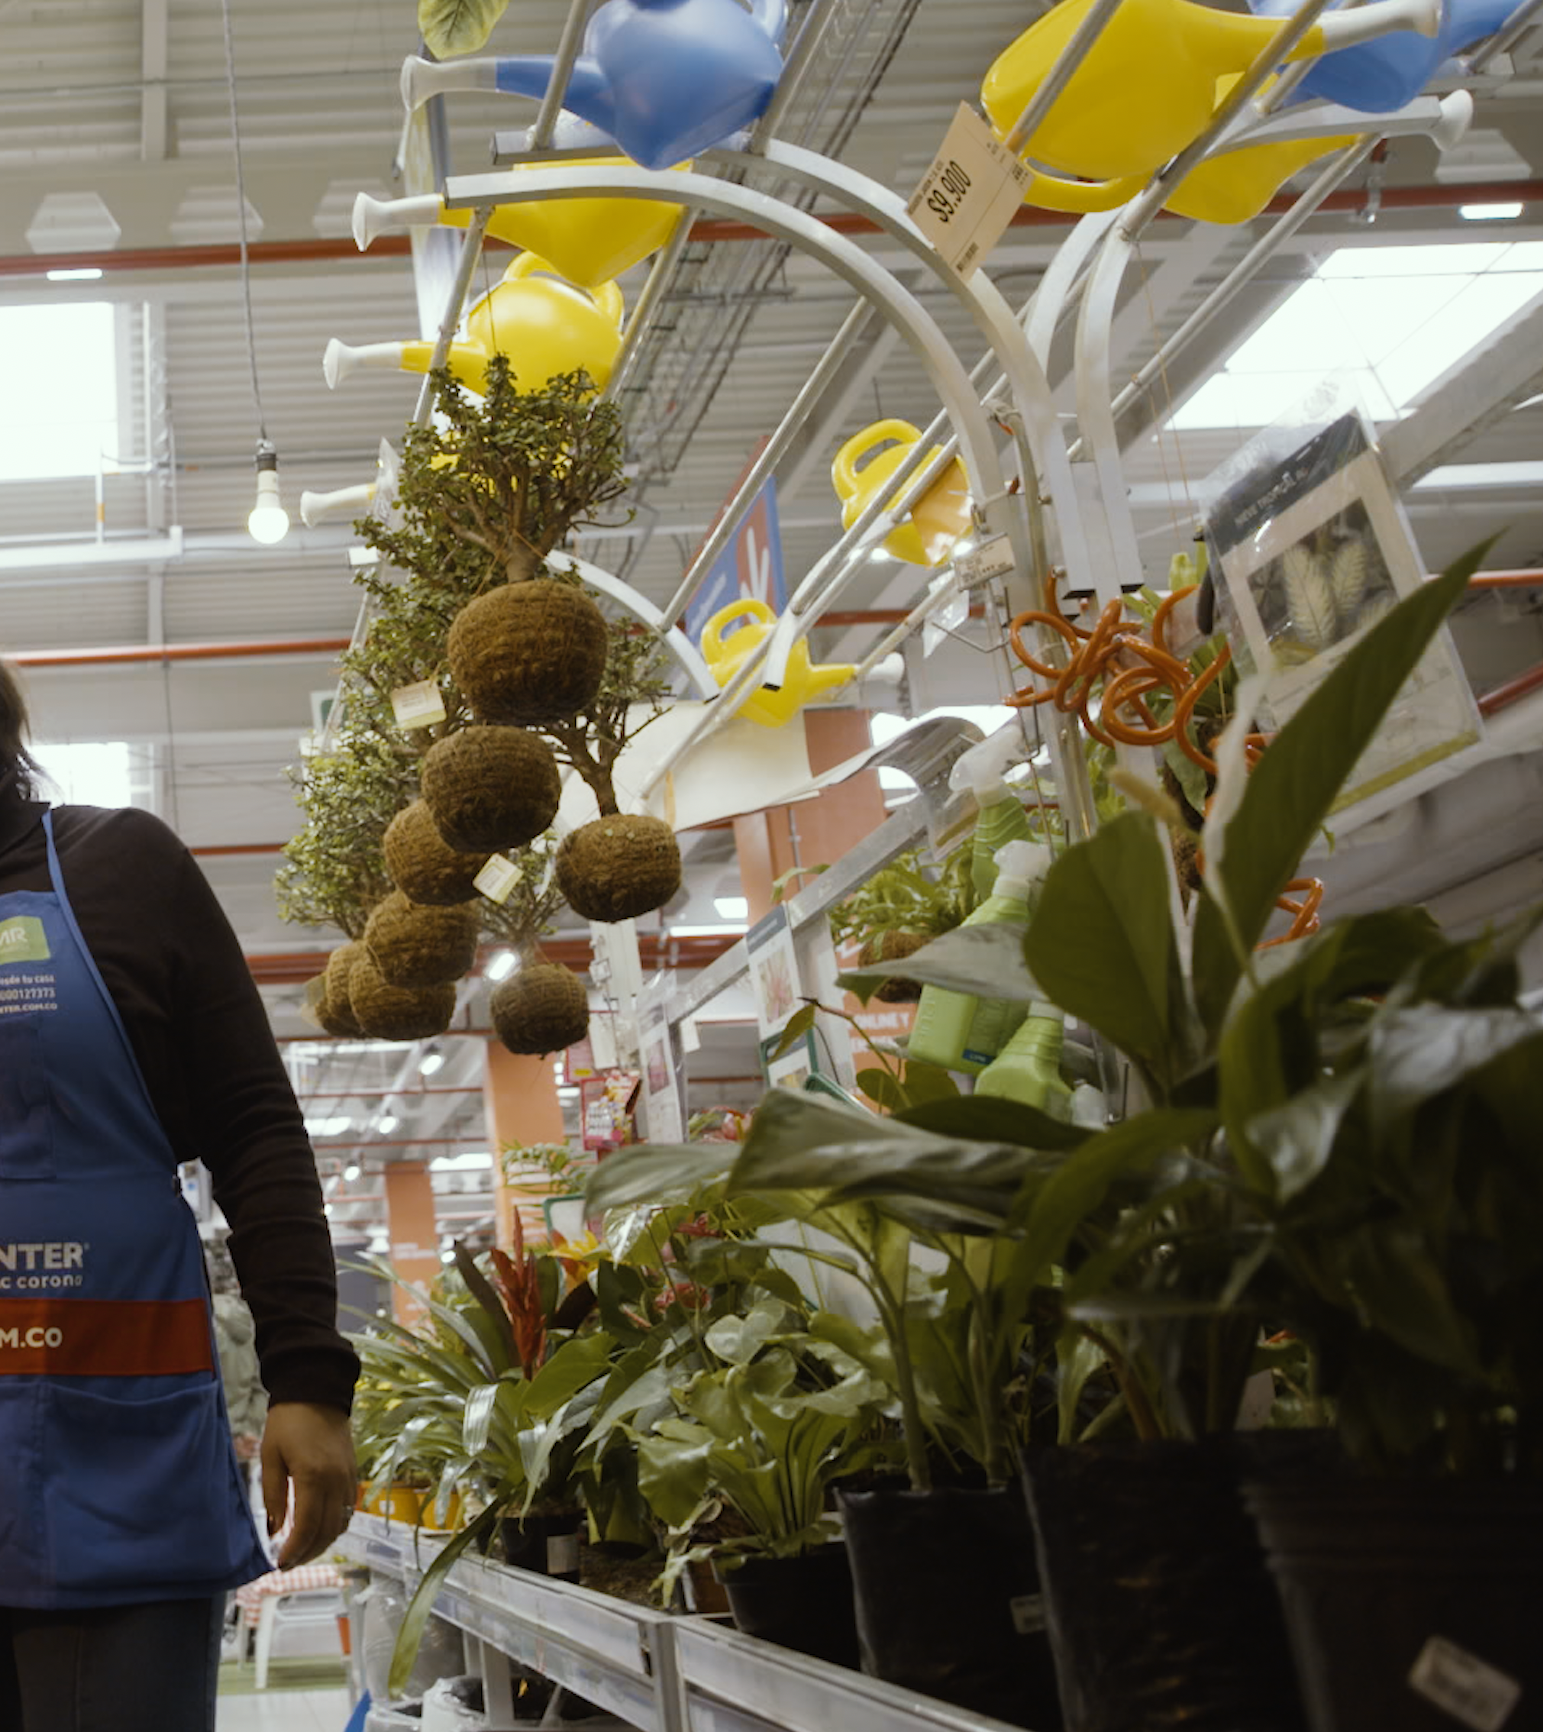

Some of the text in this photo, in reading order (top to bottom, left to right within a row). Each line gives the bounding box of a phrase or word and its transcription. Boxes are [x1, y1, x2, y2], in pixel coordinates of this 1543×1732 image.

[22, 975, 33, 984] tu
[35, 974, 55, 984] casa
[16, 1274, 83, 1289] corona
